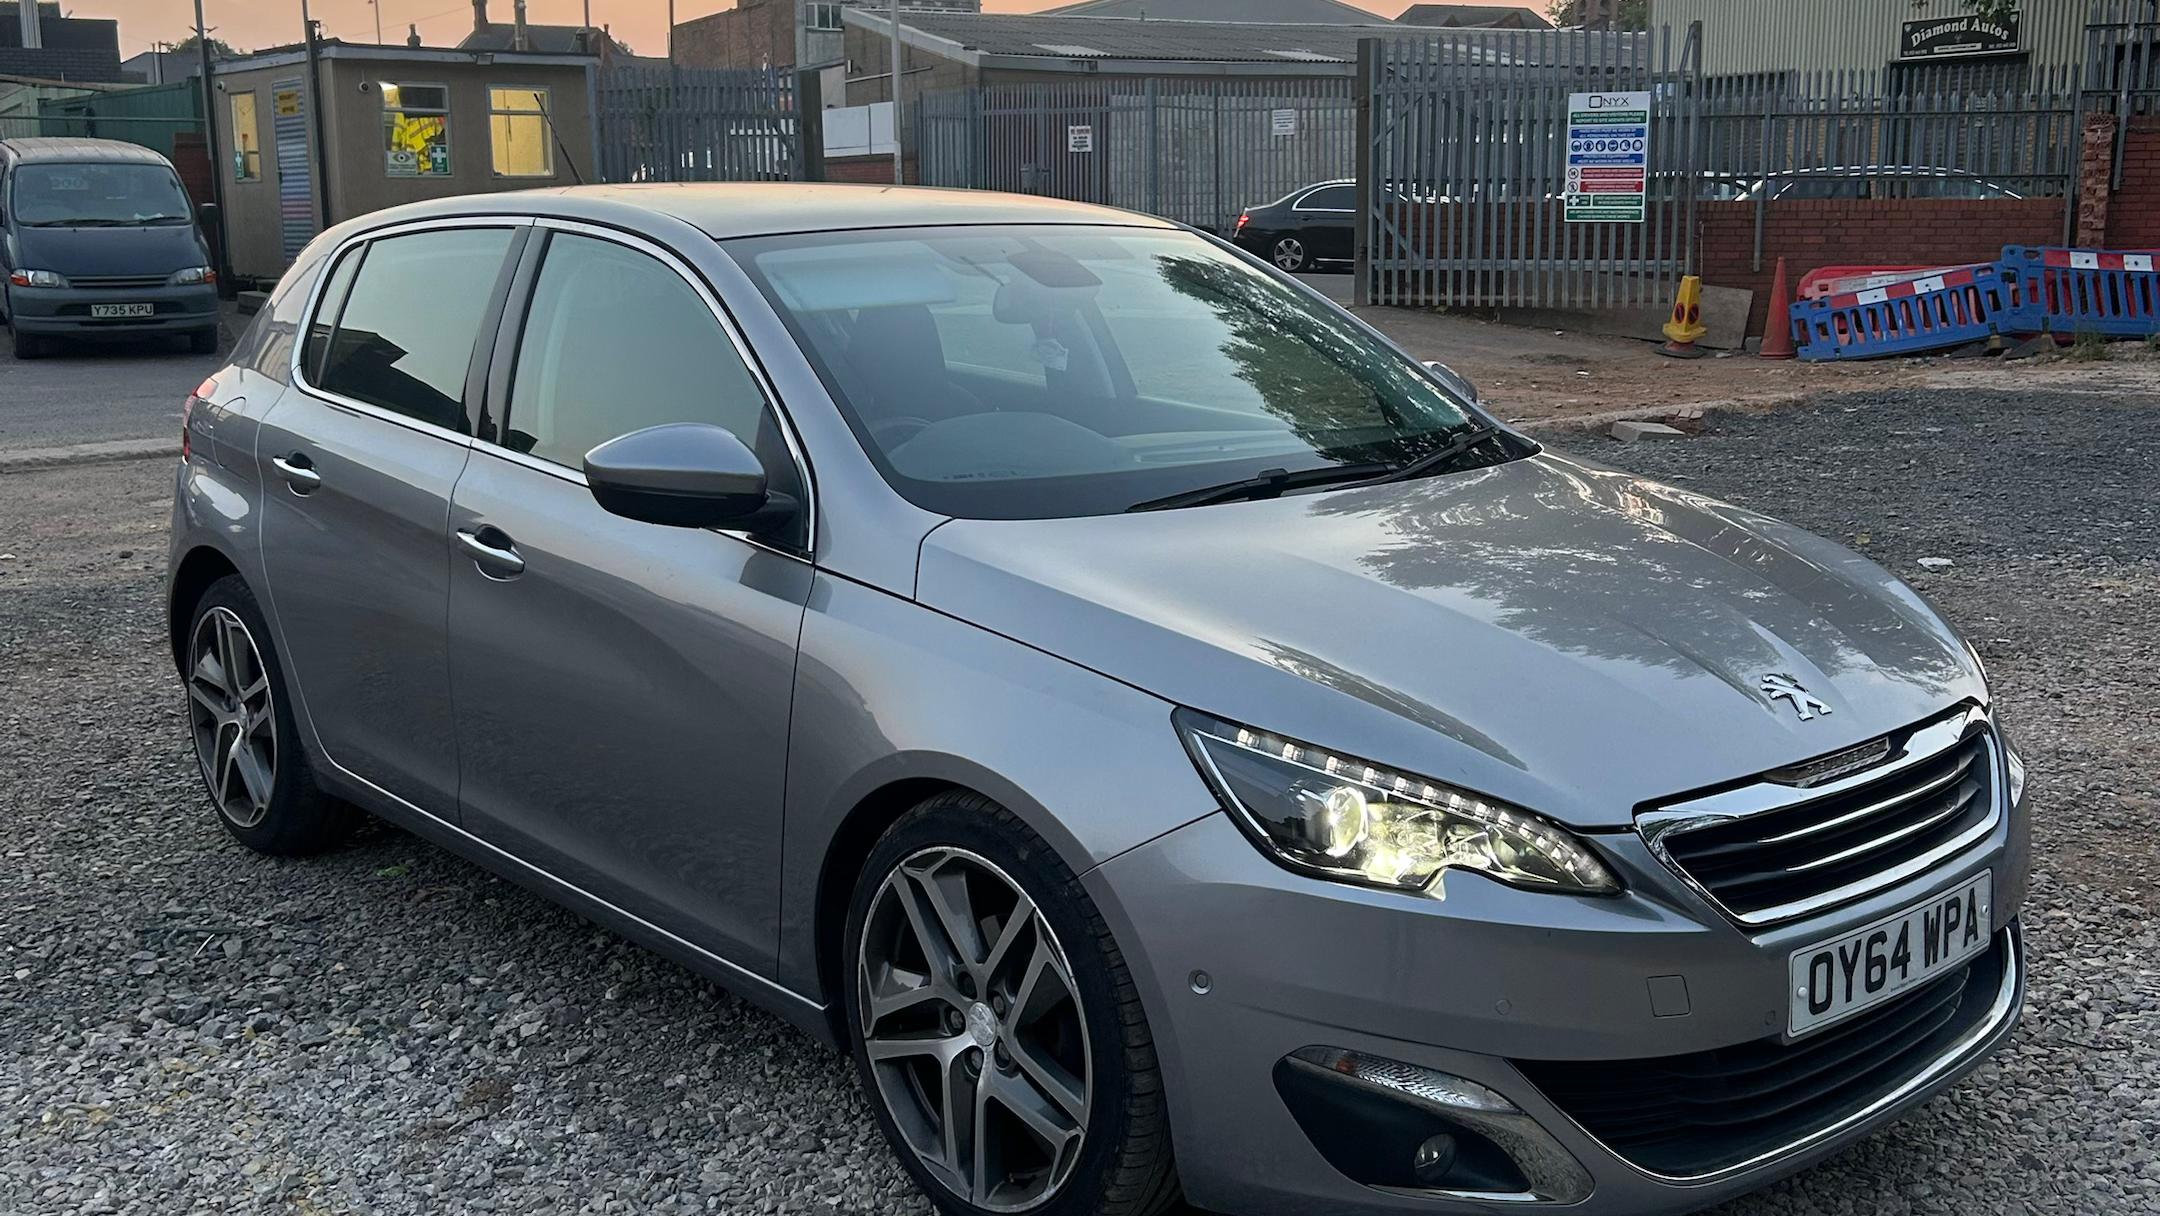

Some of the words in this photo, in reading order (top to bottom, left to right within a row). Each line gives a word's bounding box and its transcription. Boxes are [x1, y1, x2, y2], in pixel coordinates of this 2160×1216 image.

[1911, 18, 1968, 48] Diamond
[1970, 18, 2009, 41] Autos
[1588, 95, 1630, 108] ONYX
[94, 305, 126, 315] Y735
[129, 304, 152, 315] KPU
[1808, 920, 1911, 1016] OY64
[1923, 887, 1979, 969] WPA
